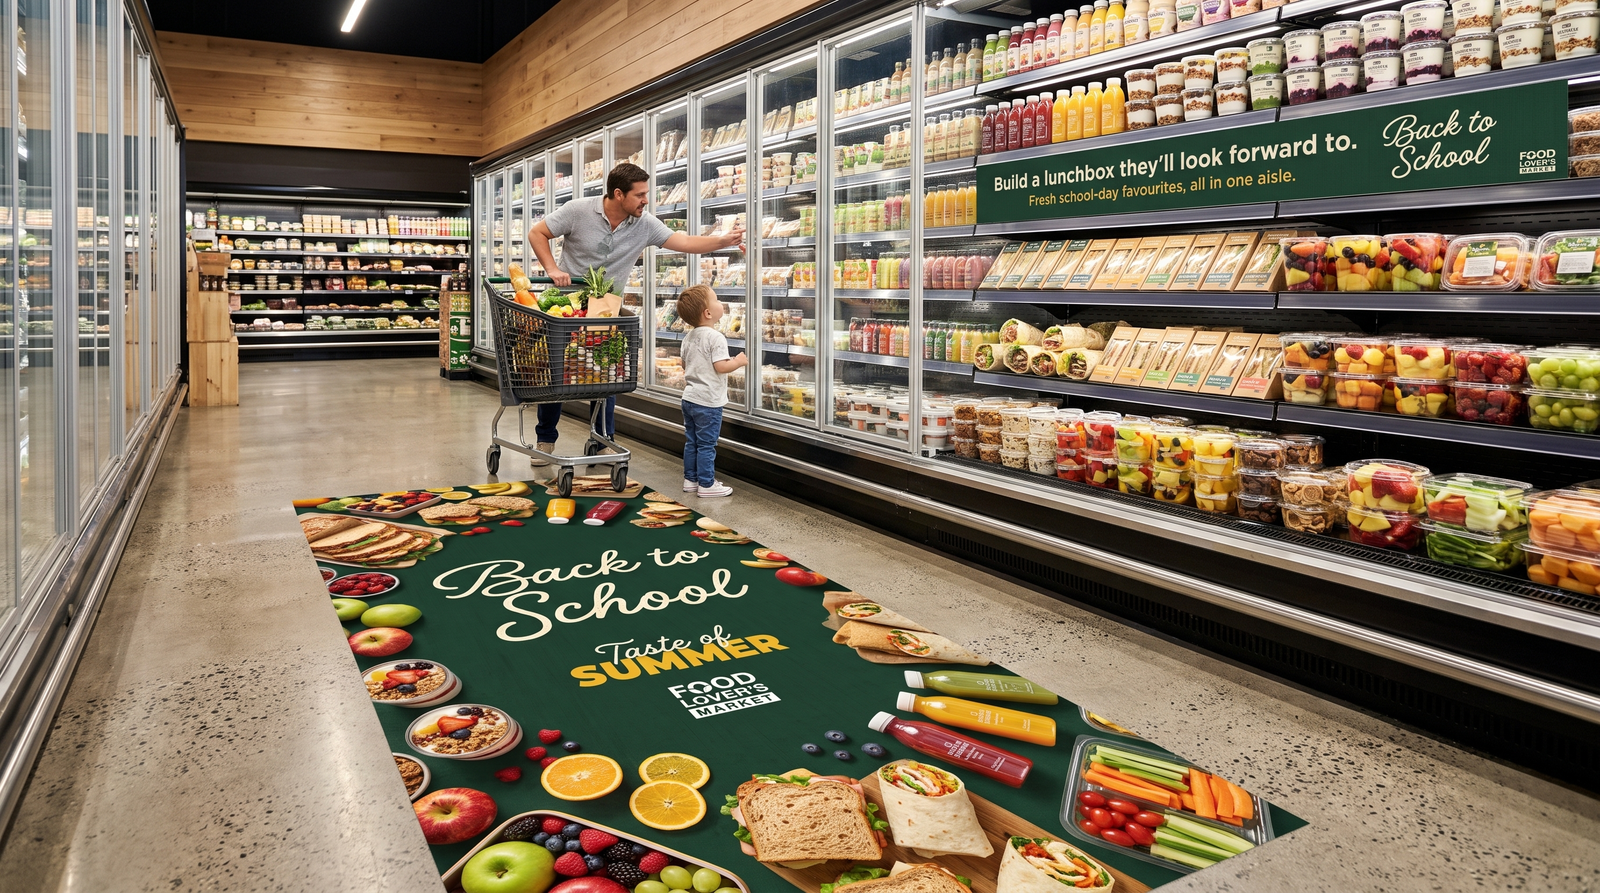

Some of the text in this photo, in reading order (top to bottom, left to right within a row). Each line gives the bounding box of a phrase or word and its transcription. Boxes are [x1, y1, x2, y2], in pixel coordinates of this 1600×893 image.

[1382, 109, 1498, 148] Back to
[994, 133, 1358, 192] Build a lunchbox they'll look forward to.
[1391, 136, 1492, 179] School
[1519, 149, 1556, 160] FOOD
[1519, 165, 1556, 174] MARKET
[1029, 168, 1296, 206] Fresh school-day favourites, all in one aisle.
[432, 548, 710, 599] Back to
[496, 568, 749, 642] School
[570, 634, 790, 688] SUMMER
[594, 624, 731, 665] Taste of
[667, 672, 756, 698] FOOD
[680, 681, 770, 710] LOVER'S
[695, 692, 775, 717] MARKET
